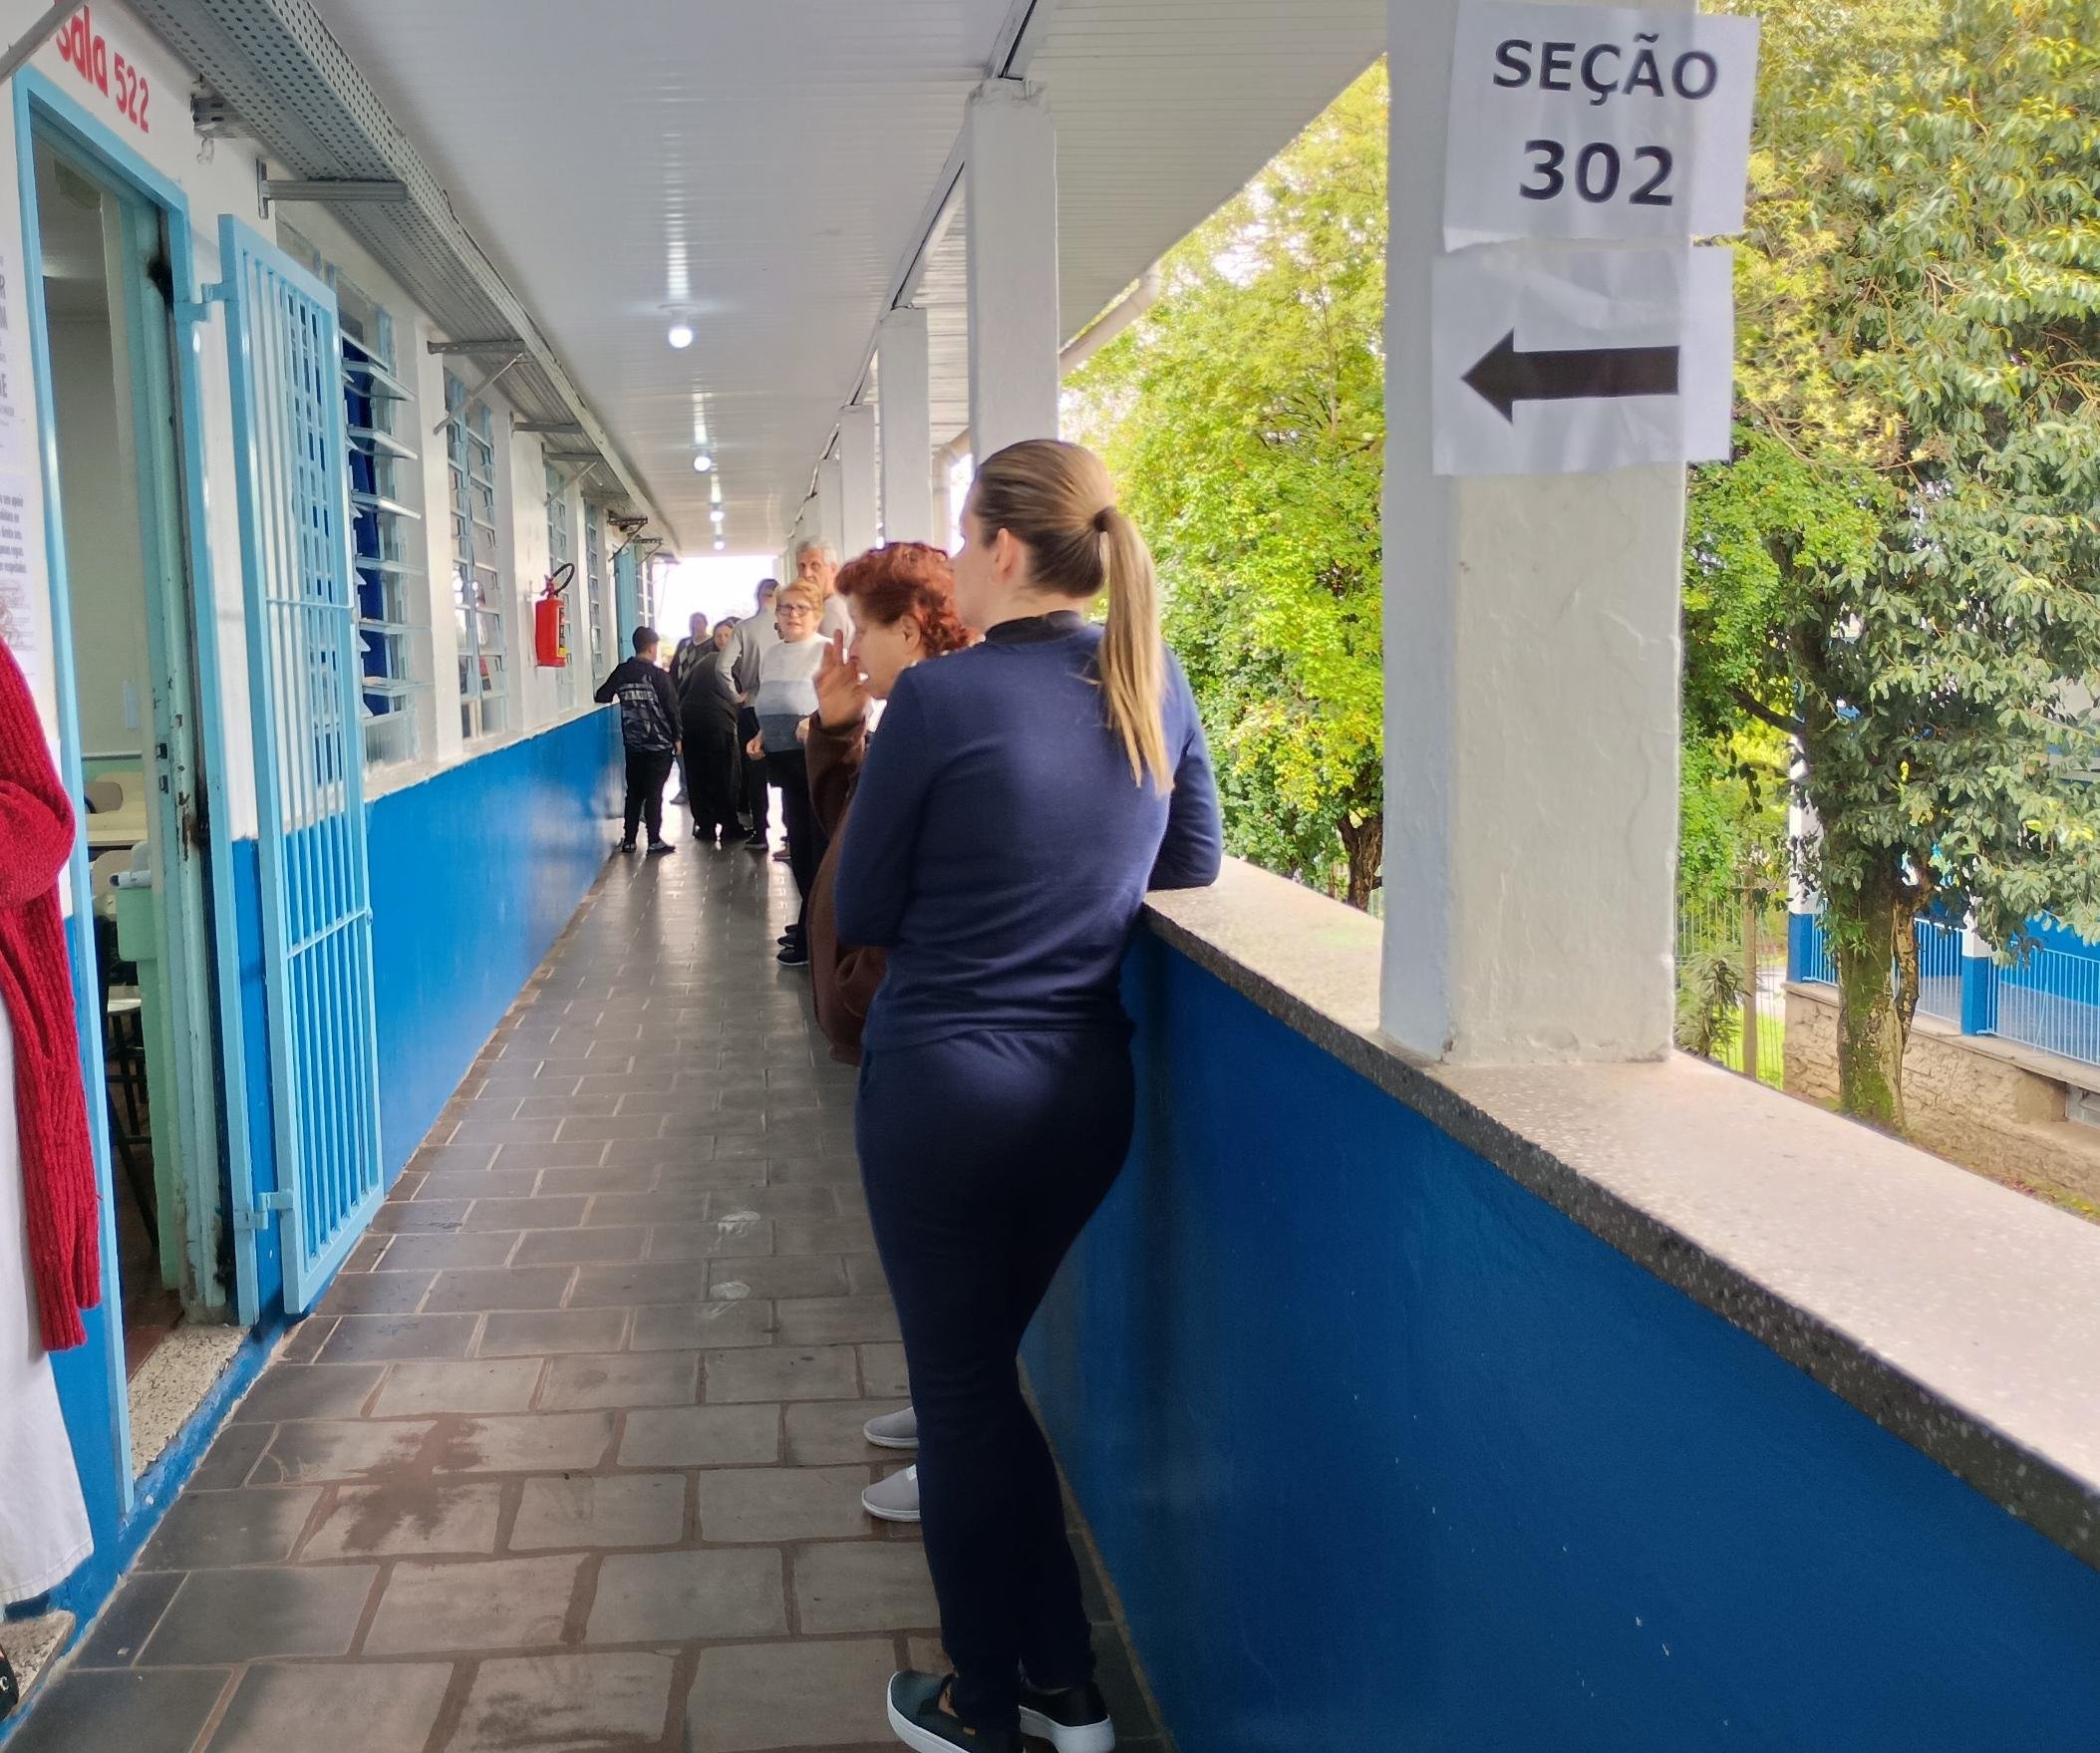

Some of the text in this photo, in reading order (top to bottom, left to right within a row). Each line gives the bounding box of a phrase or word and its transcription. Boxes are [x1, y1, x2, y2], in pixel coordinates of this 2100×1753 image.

[114, 51, 150, 134] 522
[1493, 33, 1717, 106] SEÇÃO
[1519, 140, 1674, 206] 302
